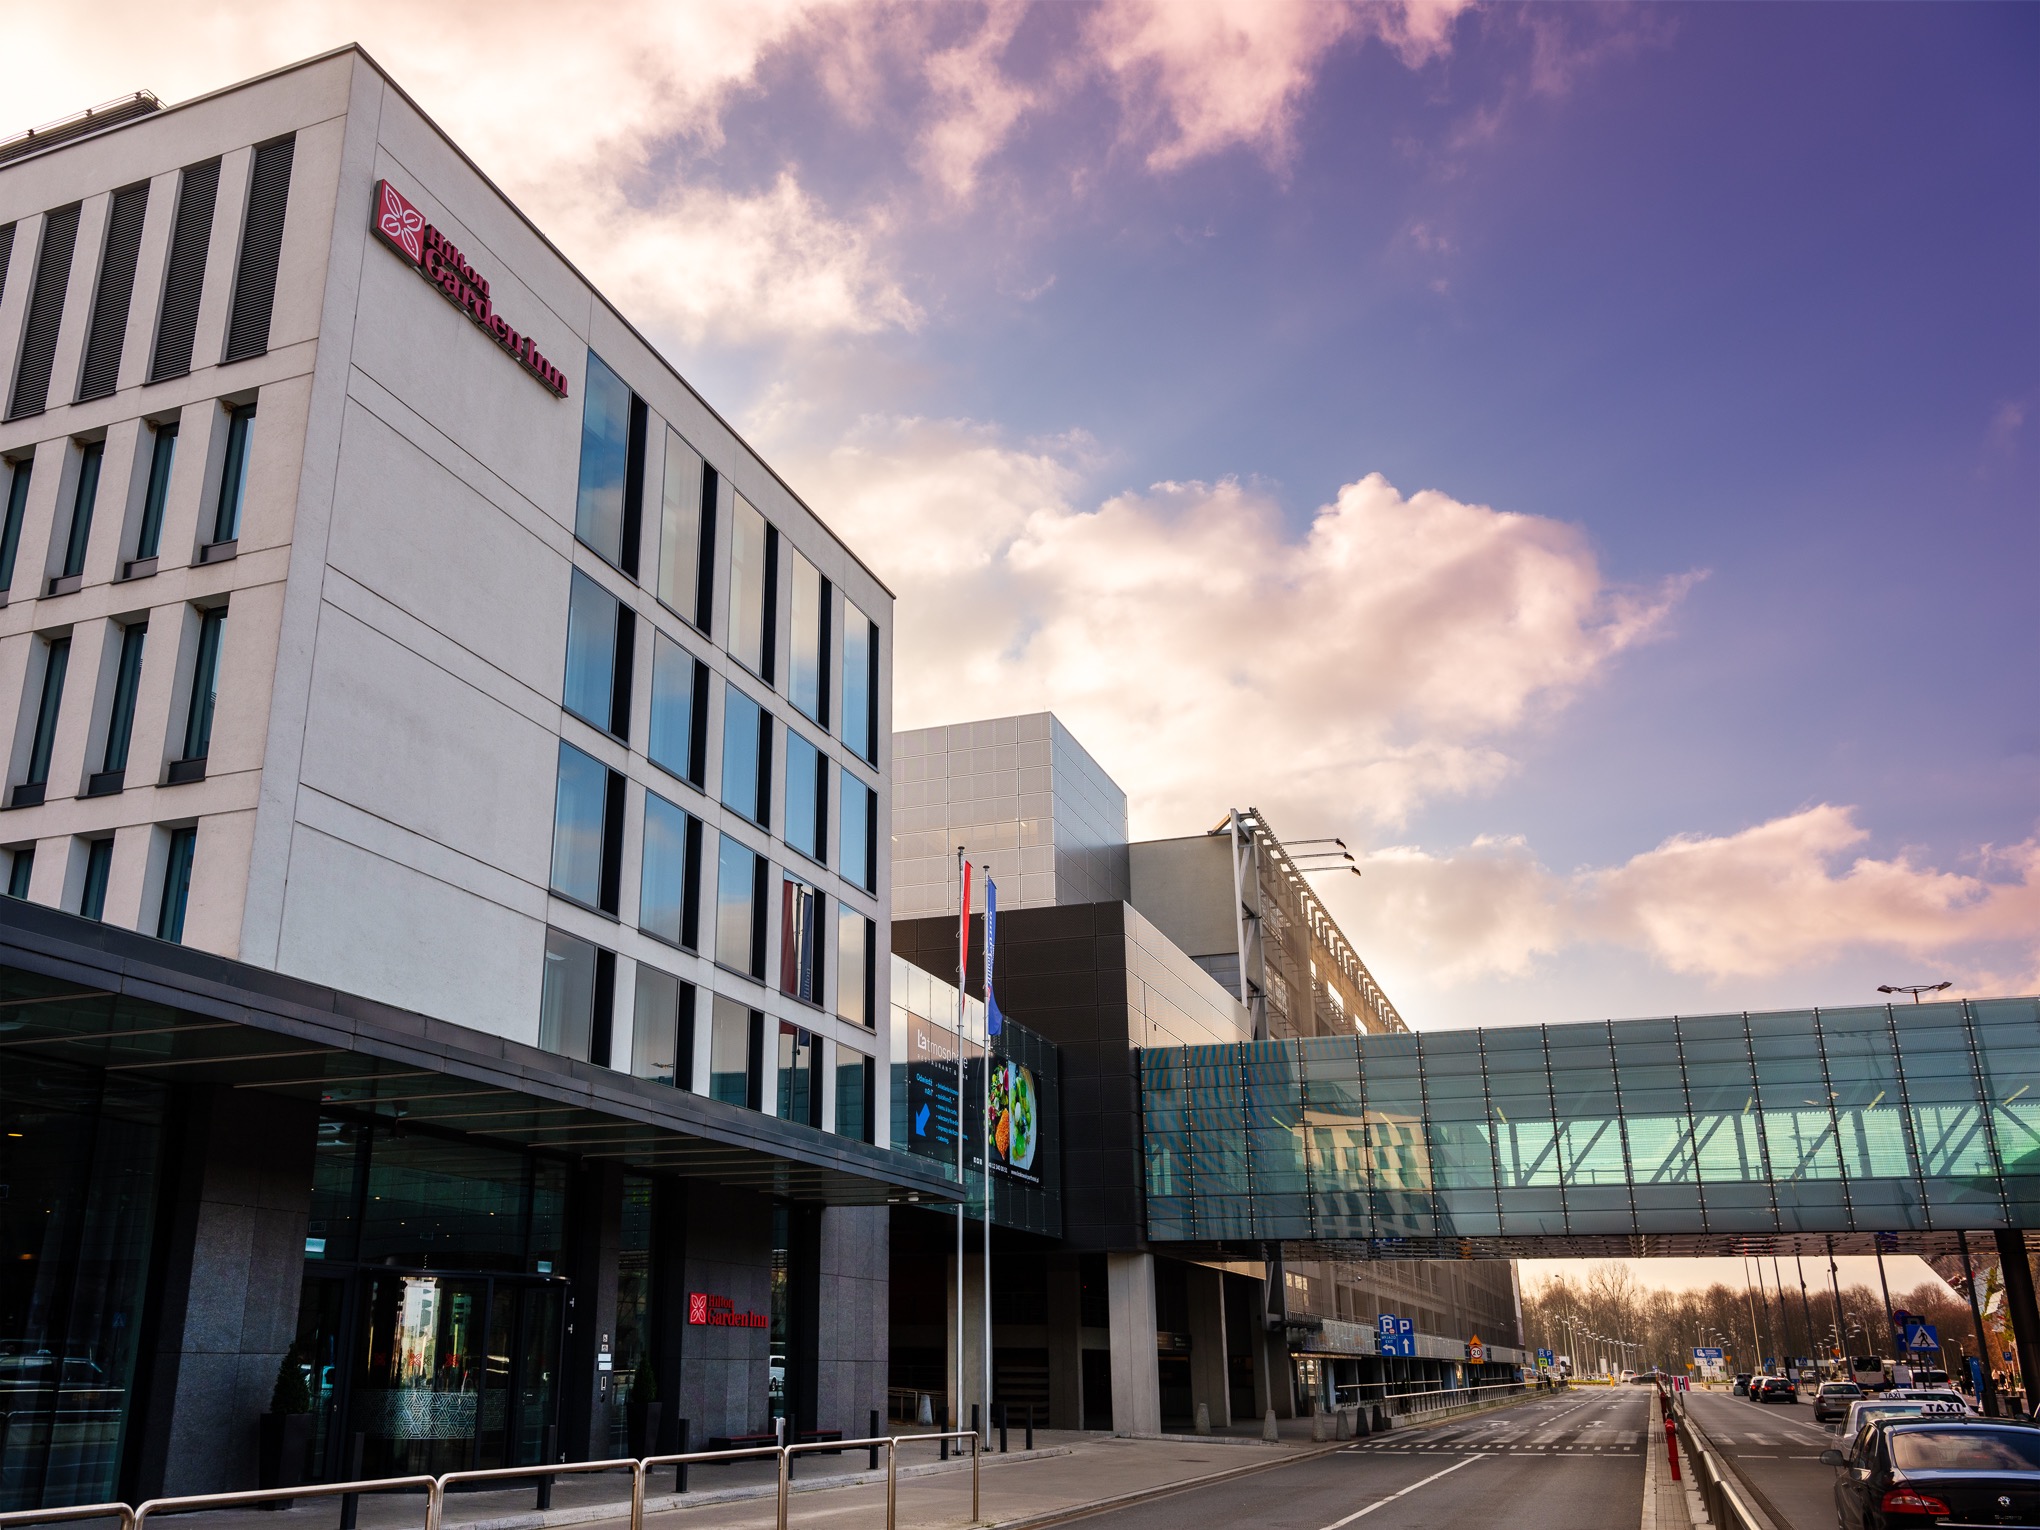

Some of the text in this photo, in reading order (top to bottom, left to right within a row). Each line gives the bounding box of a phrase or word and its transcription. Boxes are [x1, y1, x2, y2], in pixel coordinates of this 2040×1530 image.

[427, 224, 491, 298] Hilton
[423, 248, 569, 398] Garden Inn
[708, 1295, 734, 1308] Hilton
[707, 1307, 769, 1329] Garden Inn
[1383, 1320, 1393, 1332] P
[1400, 1320, 1410, 1334] P
[1926, 1403, 1961, 1413] TAXI
